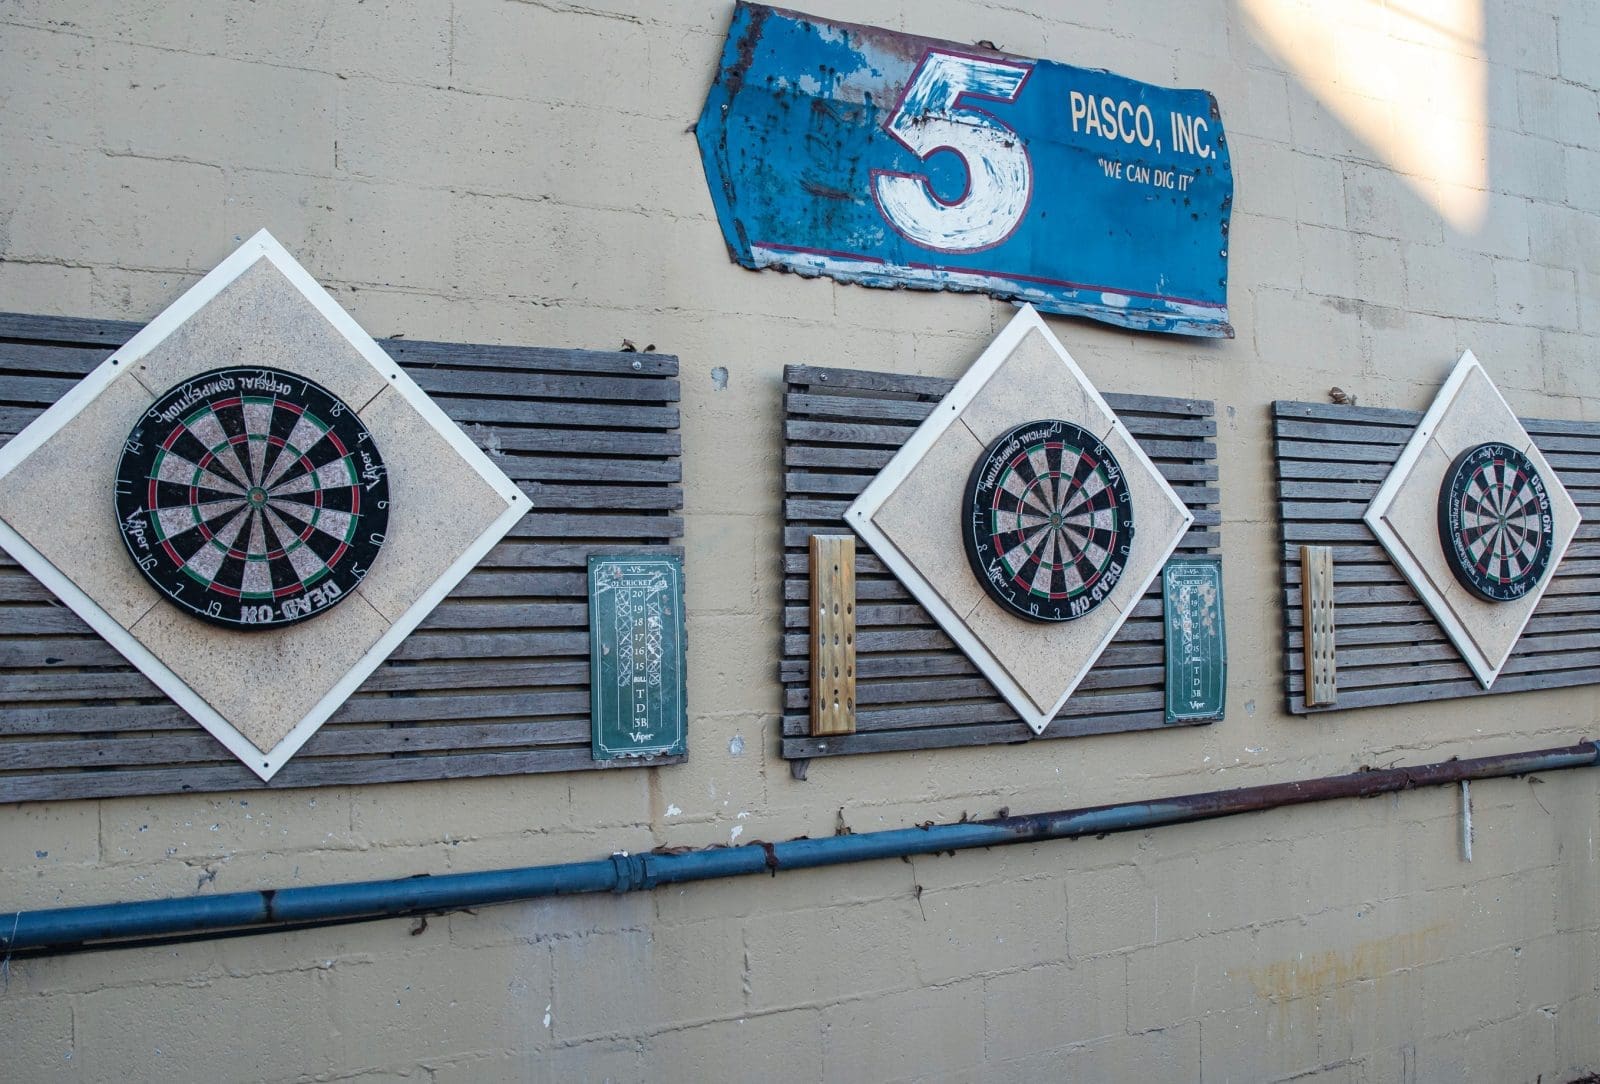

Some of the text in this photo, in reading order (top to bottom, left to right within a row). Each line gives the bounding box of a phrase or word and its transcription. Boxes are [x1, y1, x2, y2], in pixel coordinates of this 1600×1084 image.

[1070, 91, 1216, 160] PASCO, INC.
[870, 47, 1033, 254] 5
[1126, 164, 1150, 184] CAN
[1154, 169, 1175, 189] DIG
[238, 377, 292, 395] OFFICIAL
[1531, 474, 1552, 533] DEAD-ON
[1070, 561, 1122, 616] DEAD-ON
[632, 590, 643, 598] 20
[240, 579, 342, 625] DEAD-ON
[633, 605, 643, 613] 19
[634, 618, 643, 626] 18
[634, 633, 645, 641] 17
[634, 648, 645, 656] 16
[635, 662, 645, 671] 15
[636, 689, 644, 699] T
[636, 704, 646, 713] D
[634, 717, 647, 727] 3B
[629, 732, 654, 744] Viper
